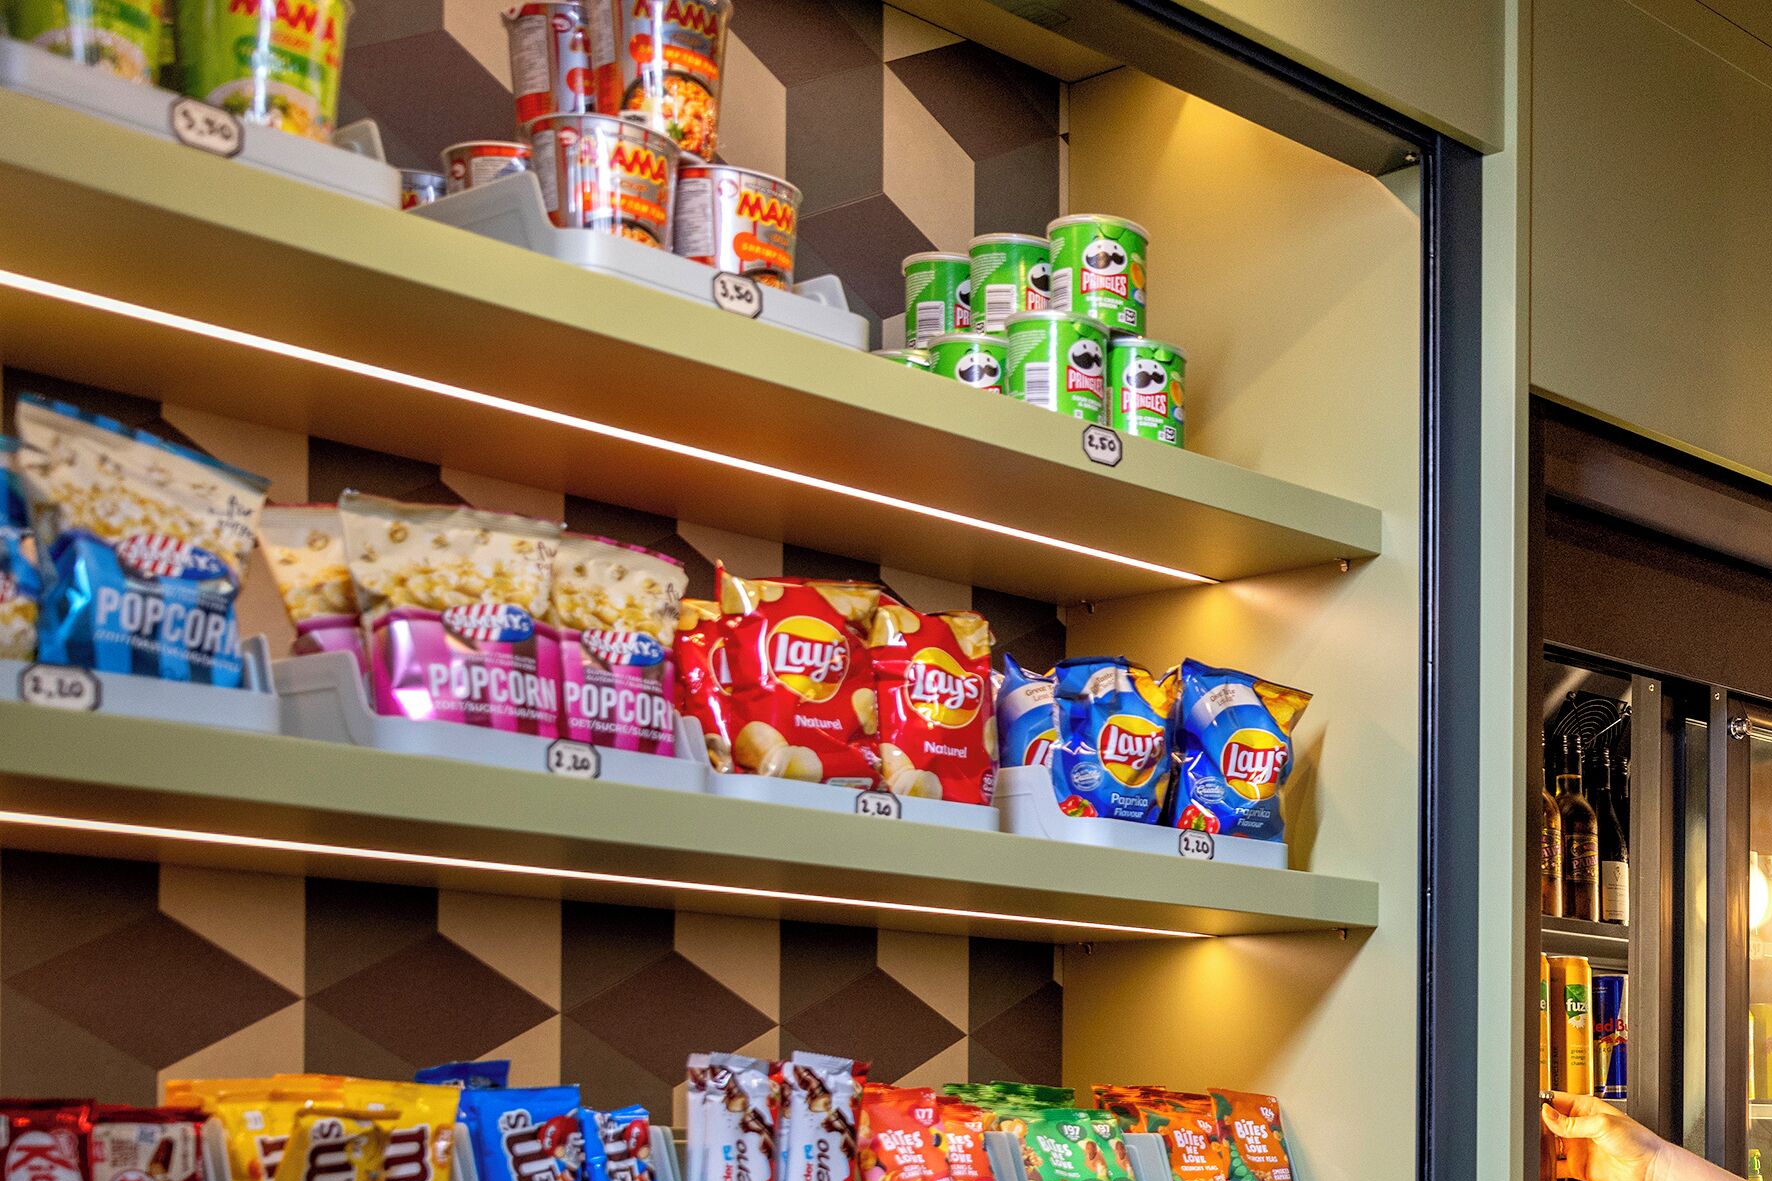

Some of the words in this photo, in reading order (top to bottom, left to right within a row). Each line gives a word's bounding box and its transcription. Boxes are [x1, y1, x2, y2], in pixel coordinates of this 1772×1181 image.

[718, 279, 755, 305] 3,50
[1082, 270, 1127, 299] PRINGLES
[1121, 389, 1168, 417] PINGLES
[1087, 434, 1116, 452] 2,50
[775, 633, 847, 682] Lay's
[428, 662, 557, 711] POPCORN
[911, 664, 979, 709] Lay's
[795, 714, 843, 731] Naturel
[923, 740, 968, 758] Naturel
[1104, 724, 1165, 770] Lay's
[1226, 743, 1288, 784] Lay's
[1111, 793, 1149, 808] Paprika
[1114, 807, 1144, 818] Flavour
[1235, 807, 1272, 820] Paprika
[1237, 818, 1264, 829] Flavour
[1592, 1018, 1614, 1033] ed
[1245, 1143, 1269, 1154] LOVE
[1182, 1153, 1207, 1164] LOVE
